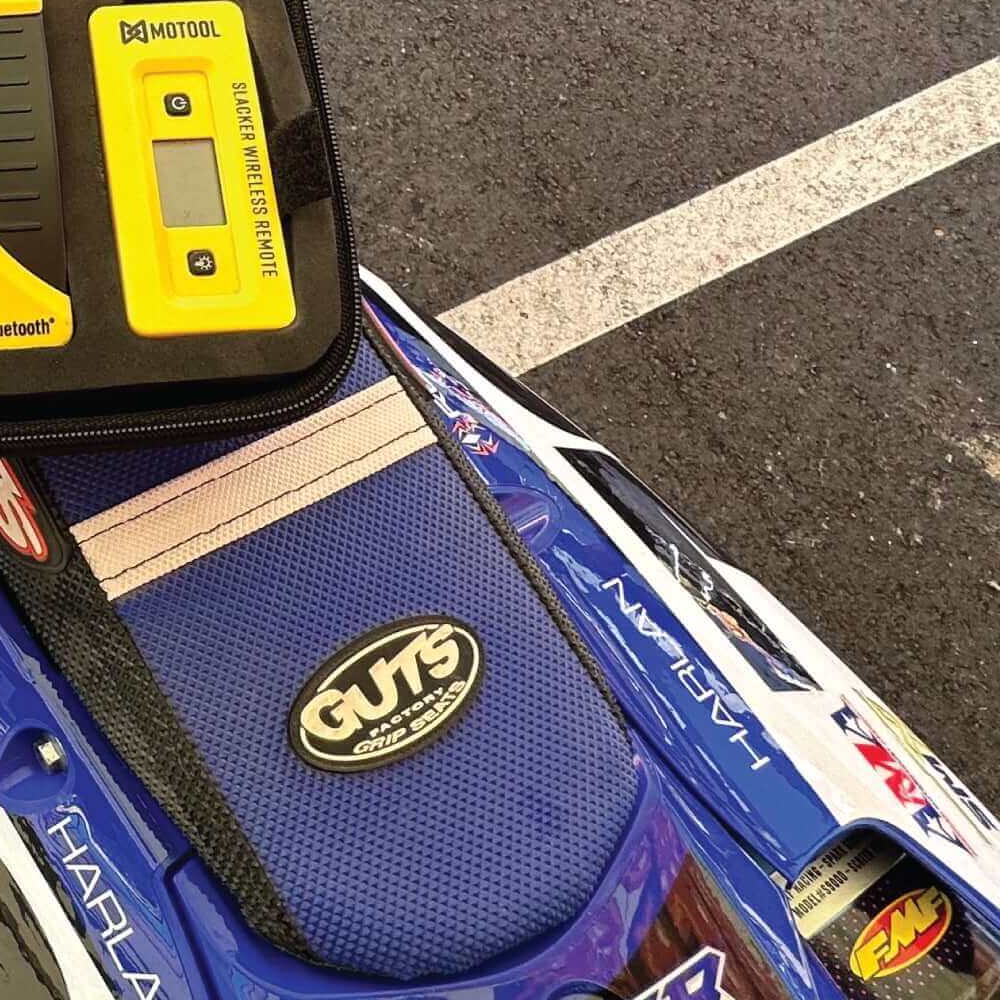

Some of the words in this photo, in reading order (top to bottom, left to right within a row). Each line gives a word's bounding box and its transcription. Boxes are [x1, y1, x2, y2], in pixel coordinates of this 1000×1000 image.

[150, 20, 221, 40] MOTOOL
[232, 82, 255, 141] SLACKER
[242, 145, 268, 215] WIRELESS
[254, 221, 279, 278] REMOTE
[300, 623, 460, 741] GUTS
[602, 576, 770, 770] HARLAN
[353, 727, 407, 754] GRIP
[411, 680, 467, 732] SEATS
[369, 687, 443, 738] FACTORY
[854, 886, 943, 981] FMF
